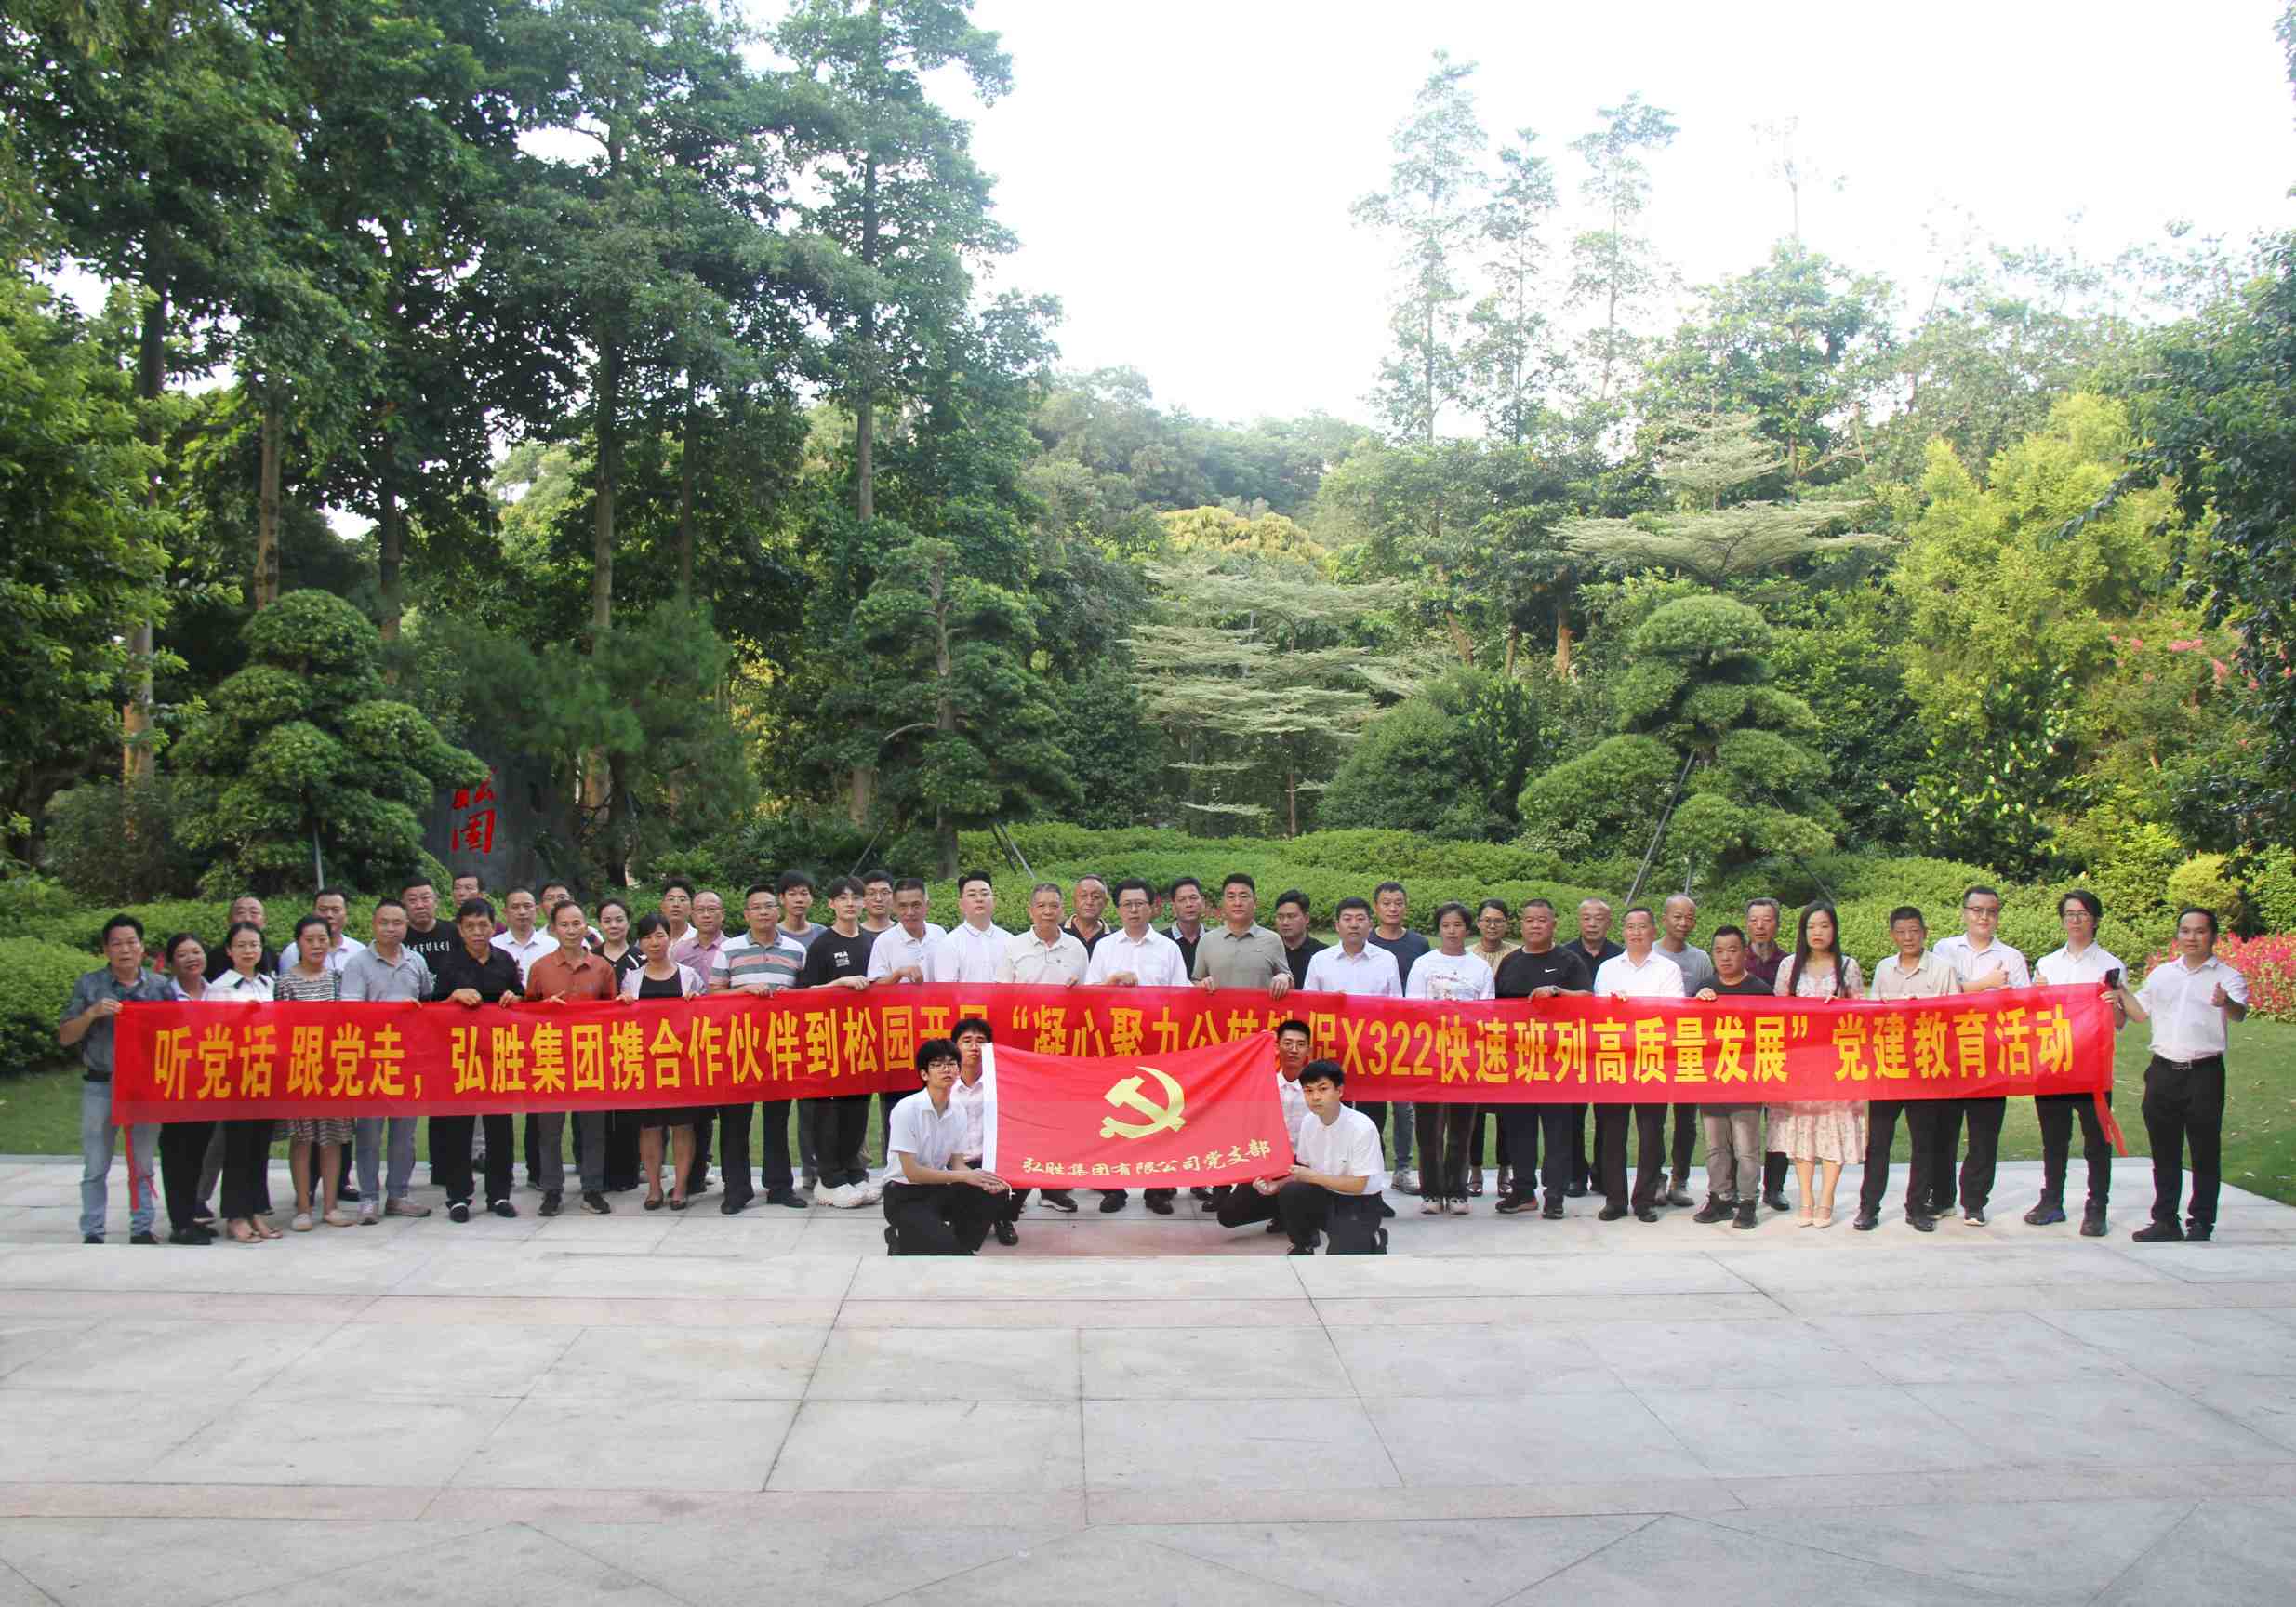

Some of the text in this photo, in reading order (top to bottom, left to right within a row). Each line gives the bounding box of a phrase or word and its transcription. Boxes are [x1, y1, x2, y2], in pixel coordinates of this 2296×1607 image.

[153, 1023, 277, 1100] 听党话
[1832, 1003, 2075, 1082] 党建教育活动
[1022, 1138, 1272, 1177] 弘胜集团有限公司党支部
